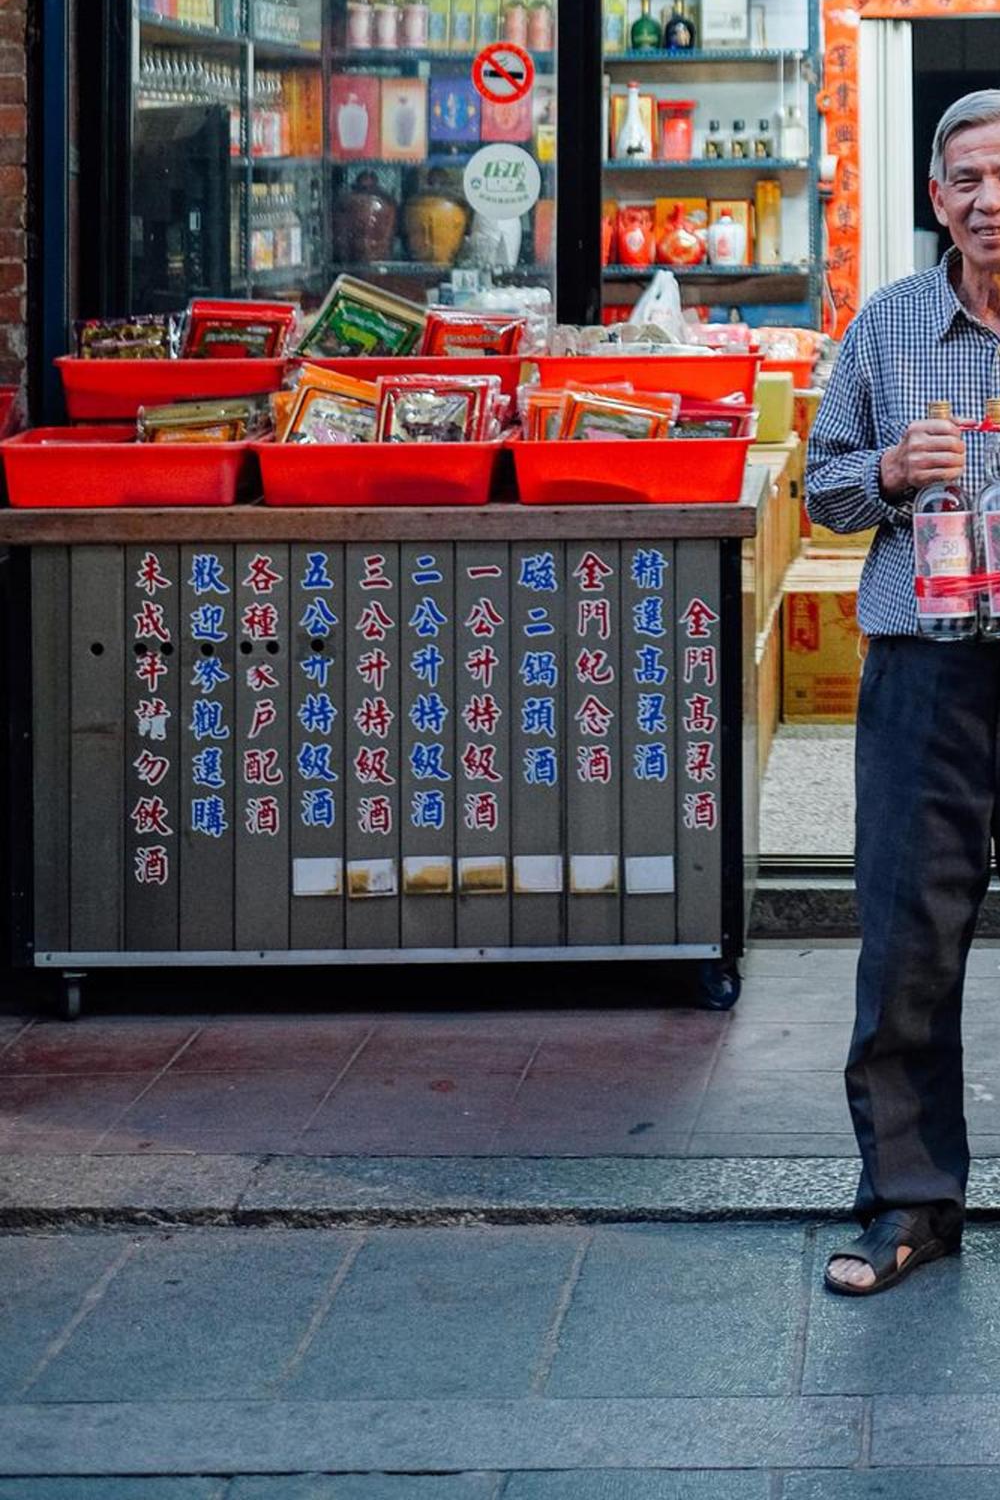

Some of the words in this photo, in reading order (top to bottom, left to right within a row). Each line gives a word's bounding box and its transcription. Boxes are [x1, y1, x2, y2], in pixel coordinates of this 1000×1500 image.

[297, 551, 338, 828] 五公升特級酒
[354, 554, 396, 834] 三公升特級酒
[408, 555, 452, 830] 二公升特級酒
[461, 564, 504, 830] 一公升特級酒
[518, 552, 558, 787] 磁二鍋頭酒
[572, 551, 615, 785] 金門紀念酒
